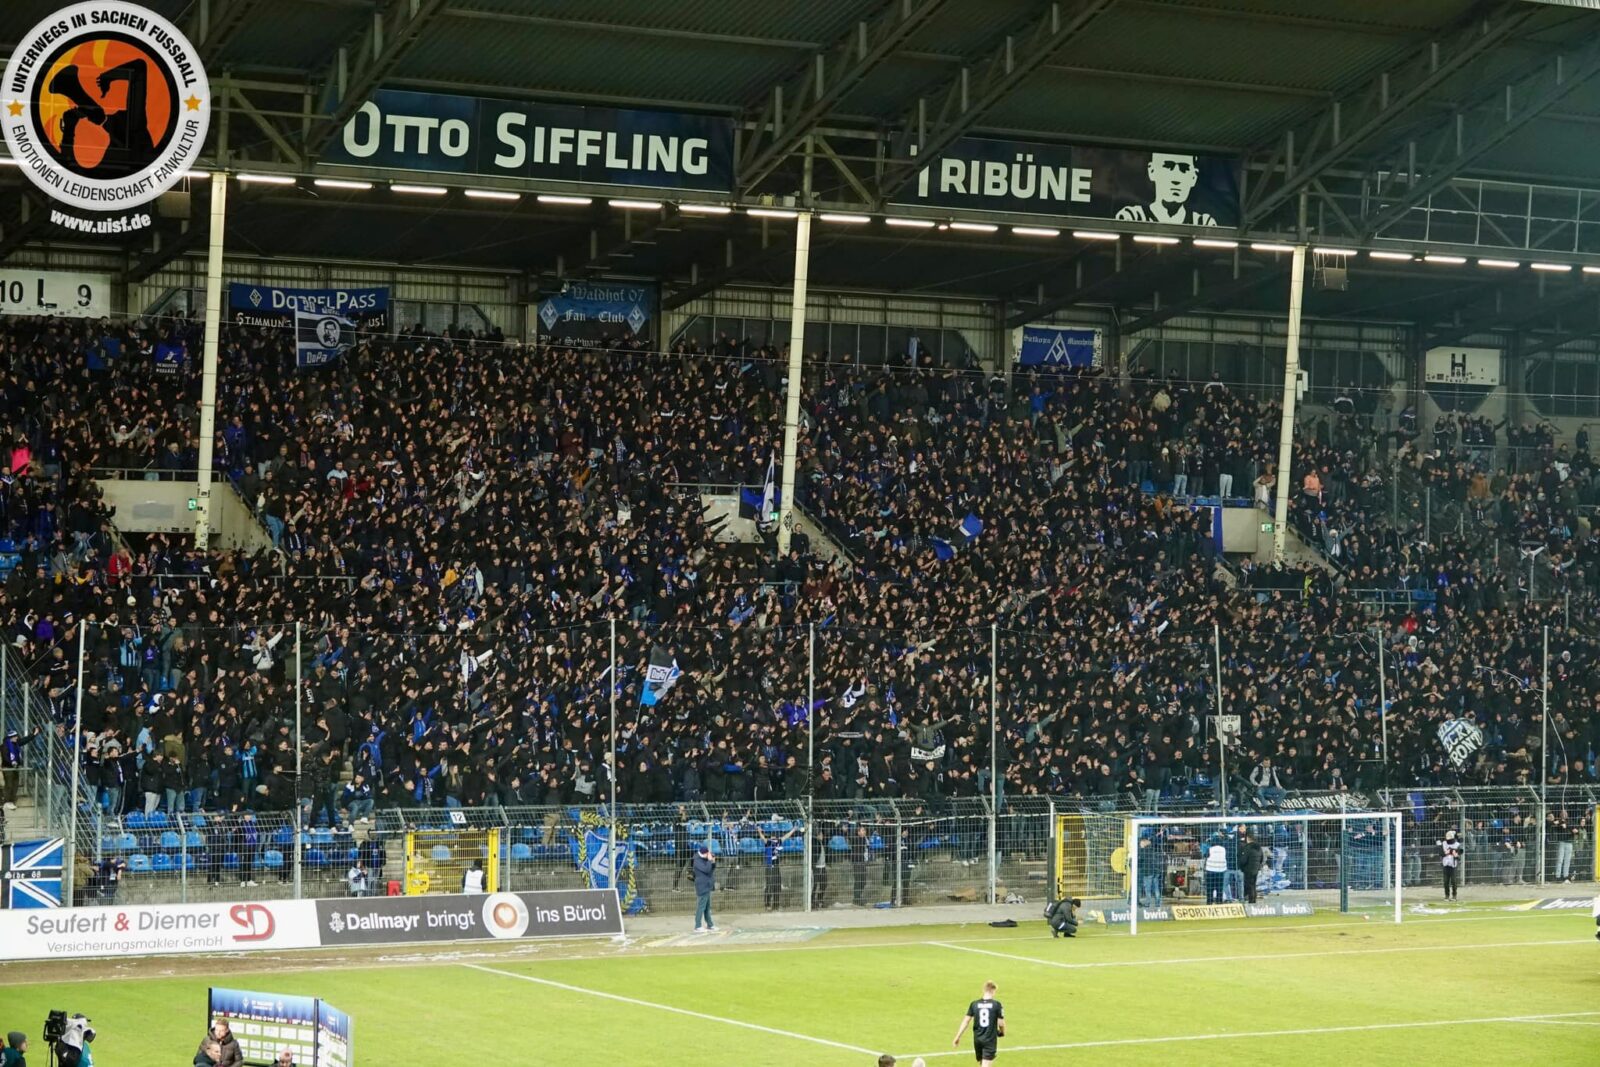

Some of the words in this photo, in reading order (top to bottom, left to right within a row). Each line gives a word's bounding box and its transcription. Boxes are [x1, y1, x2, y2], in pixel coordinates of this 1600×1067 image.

[77, 284, 92, 306] 9
[346, 912, 420, 932] Dallmayr
[427, 909, 475, 930] bringt
[536, 906, 560, 923] ins
[564, 904, 607, 923] Büro!
[1111, 910, 1132, 922] bwi
[1143, 908, 1168, 920] bwin
[1175, 907, 1245, 919] SPORTWETTEN
[1251, 903, 1276, 915] bwin
[1282, 903, 1308, 914] bwin
[27, 914, 107, 936] Seufert
[114, 912, 130, 931] &
[138, 911, 220, 931] Diemer
[47, 938, 179, 953] Versicherungsmakler
[183, 935, 223, 947] GmbH
[979, 1008, 989, 1027] 8
